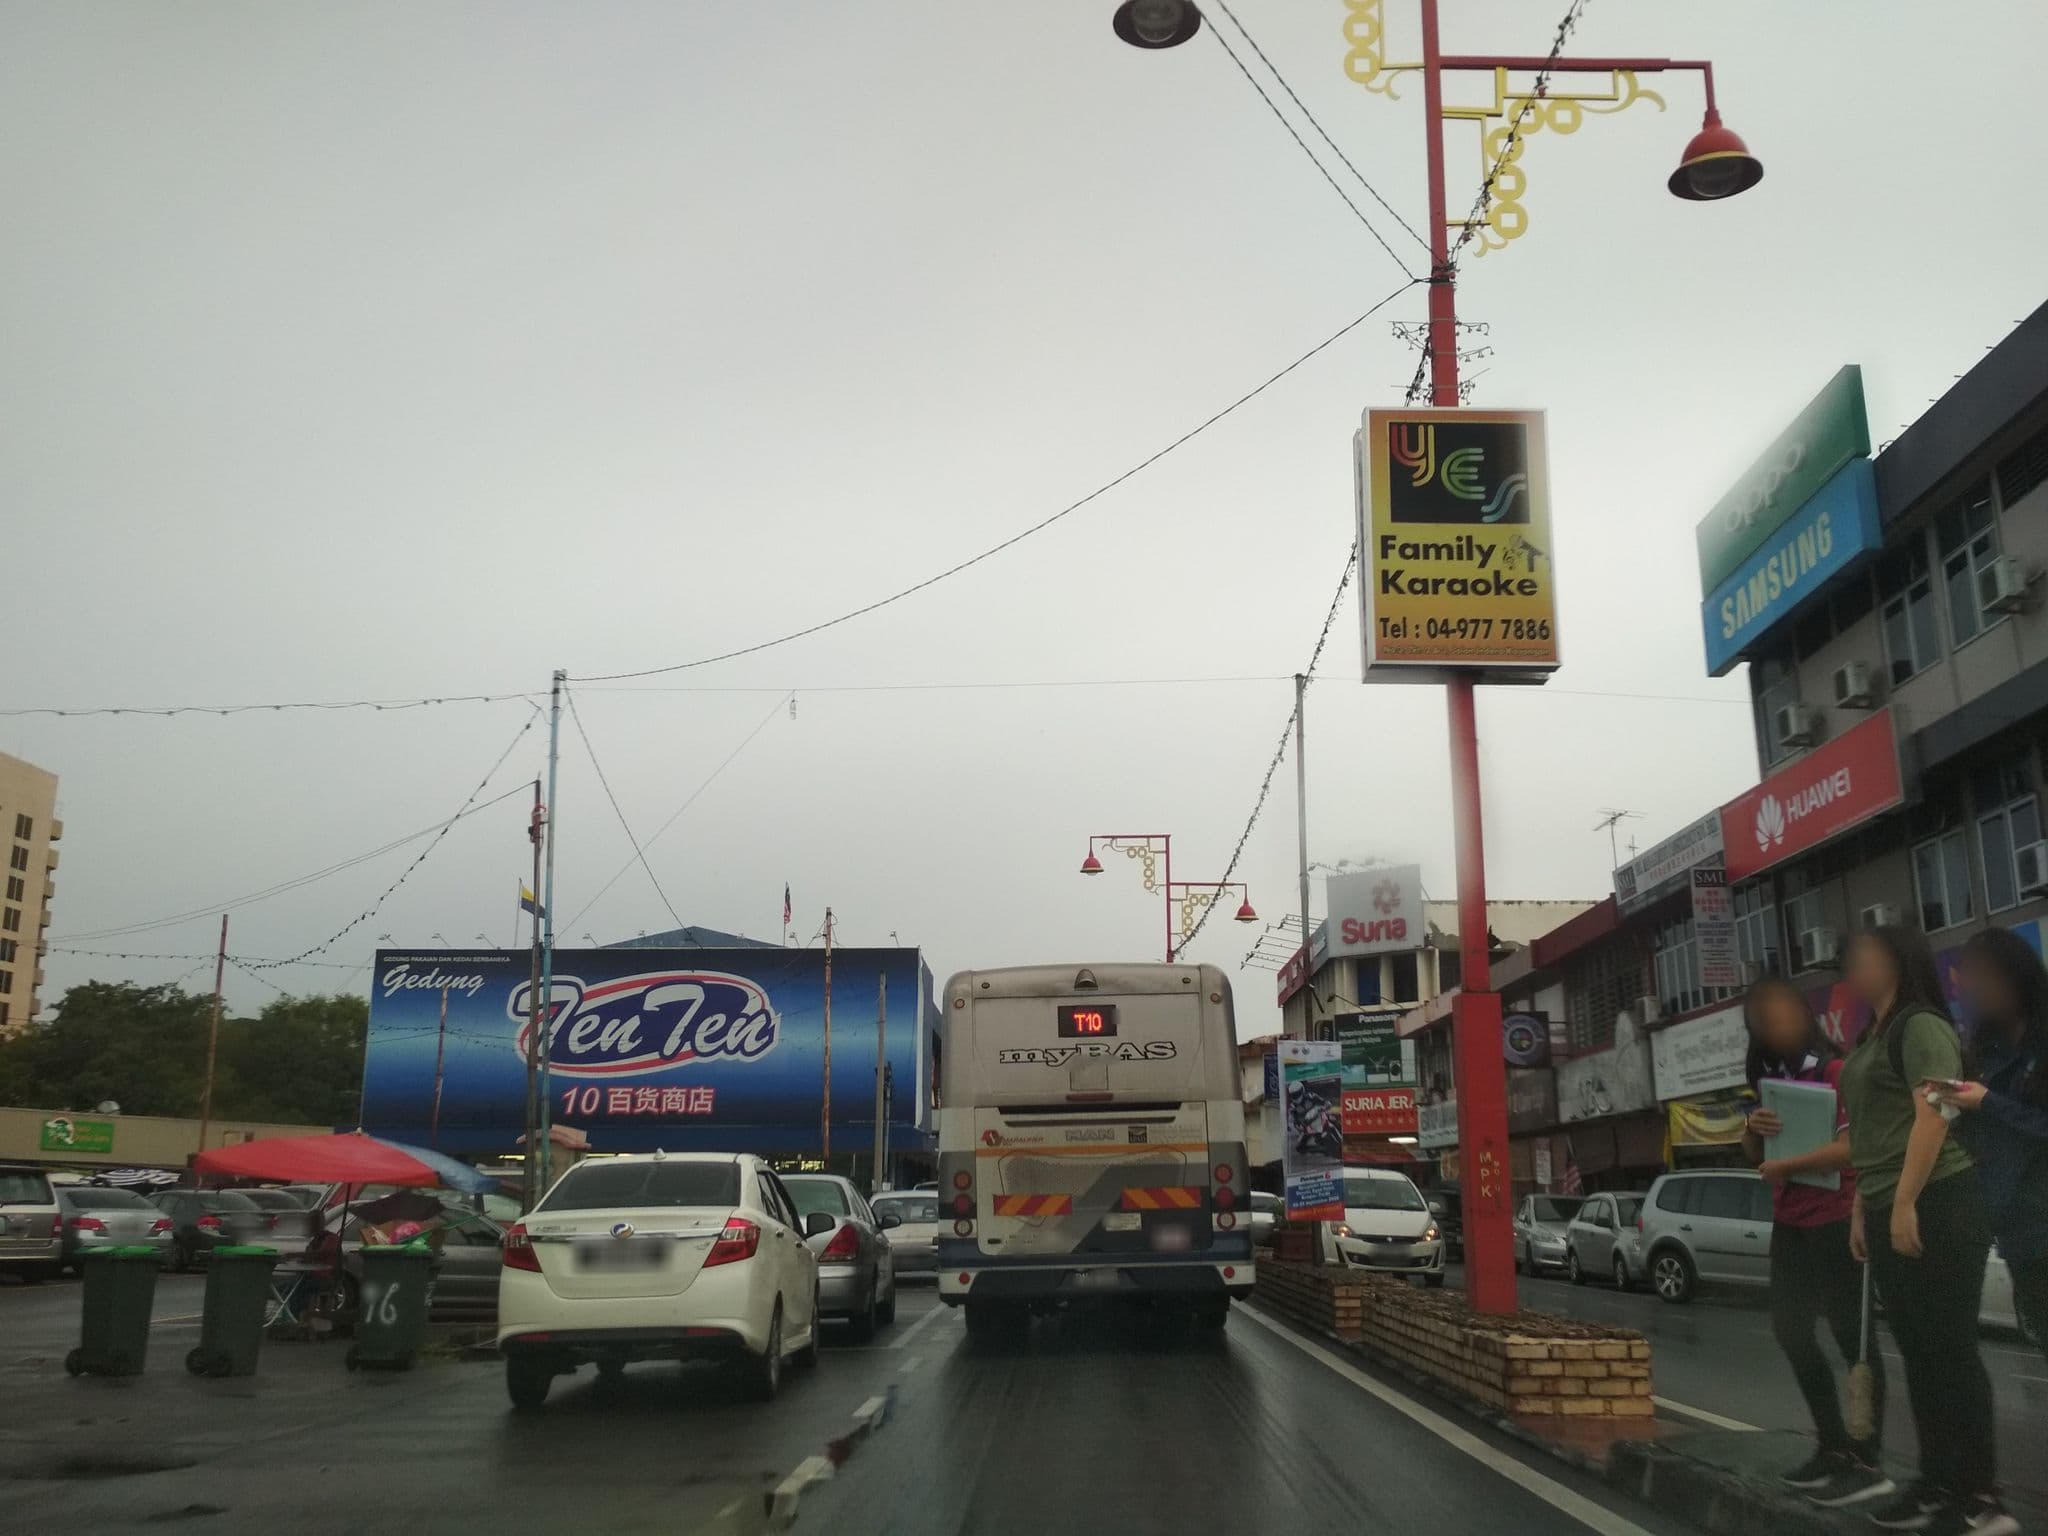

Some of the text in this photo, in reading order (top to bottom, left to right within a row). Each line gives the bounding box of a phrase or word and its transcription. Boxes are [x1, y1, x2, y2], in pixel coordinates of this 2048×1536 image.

[1379, 534, 1497, 569] Family
[1380, 569, 1539, 597] Karaoke
[1721, 512, 1833, 639] SAMSUNG
[1426, 618, 1497, 641] 04-977
[1501, 618, 1550, 641] 7886
[1786, 767, 1852, 824] HUAWEI
[383, 963, 485, 997] Gedung
[516, 982, 770, 1055] Ten Ten
[1073, 1011, 1103, 1033] T10
[1000, 1041, 1178, 1067] myBAS
[563, 1086, 715, 1115] 10 百货商店
[1344, 1096, 1385, 1111] SURIA
